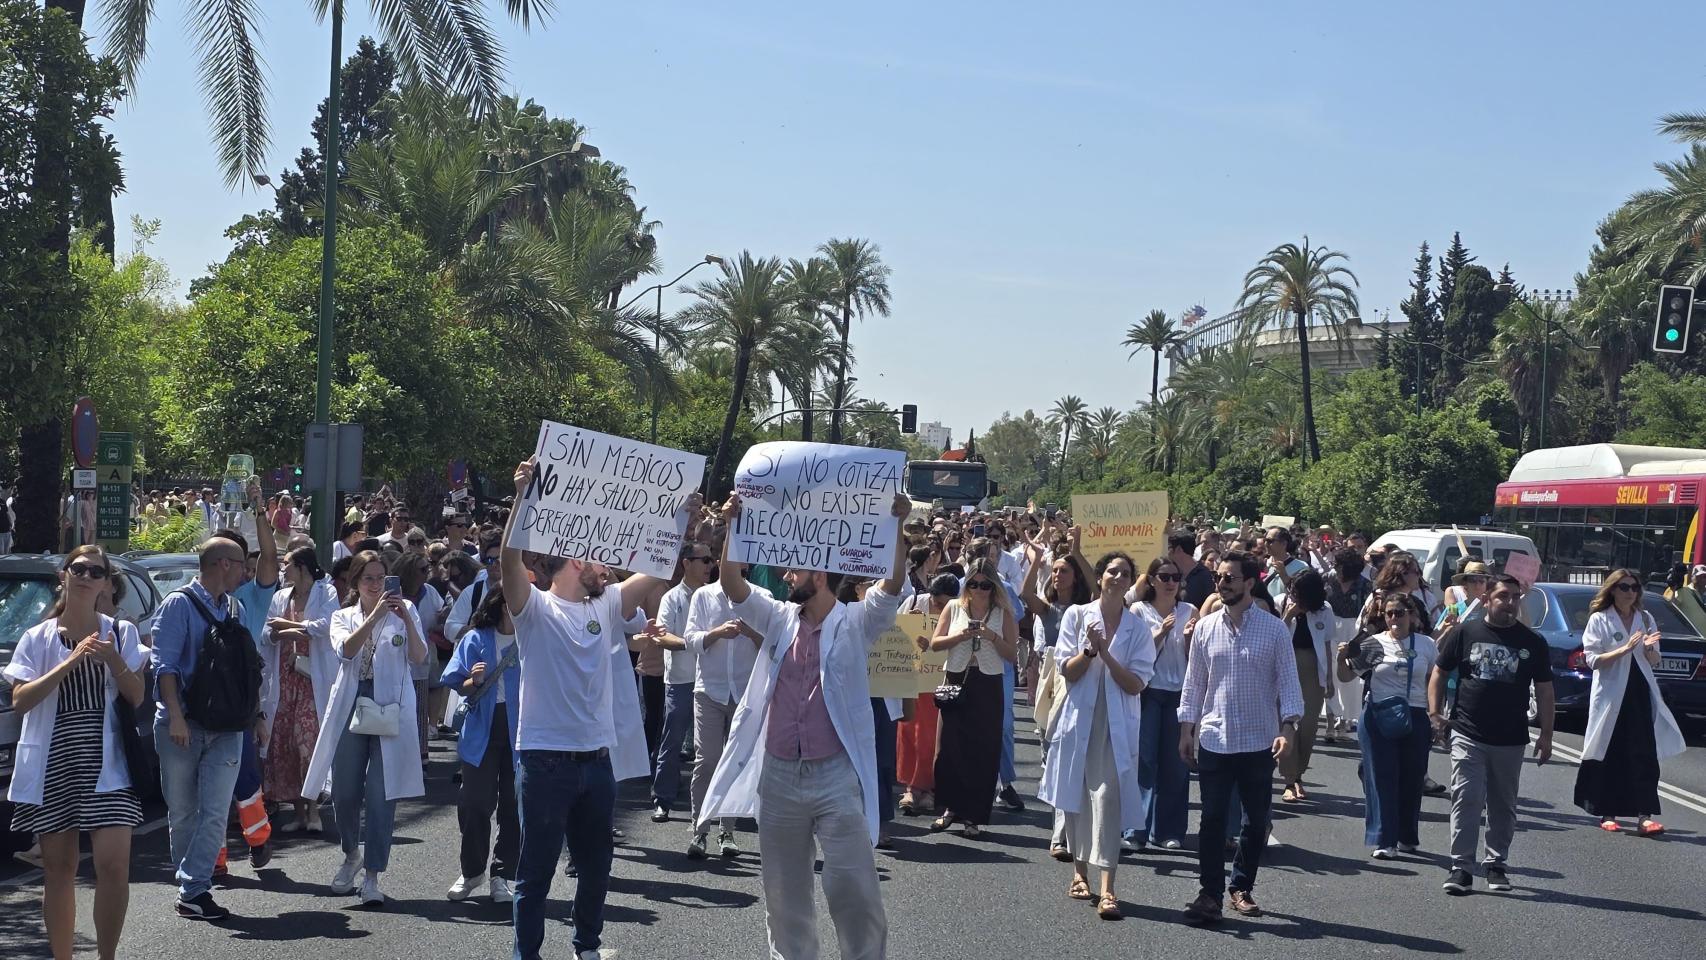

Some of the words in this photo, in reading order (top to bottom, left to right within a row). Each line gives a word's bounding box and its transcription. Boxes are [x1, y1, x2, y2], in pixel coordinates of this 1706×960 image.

[109, 468, 120, 480] A
[600, 445, 686, 492] MÉDICOS
[747, 447, 784, 478] SI
[797, 453, 829, 484] NO
[837, 461, 900, 494] COTIZA
[560, 475, 597, 506] HAY
[649, 492, 684, 519] SIN
[781, 485, 811, 511] NO
[821, 491, 881, 516] EXISTE
[1615, 485, 1649, 504] SEVILLA
[1082, 502, 1122, 519] SALVAR
[1126, 500, 1159, 517] VIDAS
[521, 505, 592, 540] DERECHOS
[590, 516, 613, 543] NO
[613, 519, 645, 550] HAY
[859, 522, 886, 549] EL
[1112, 522, 1154, 537] DORMIR
[741, 540, 832, 570] TRABAJO!
[839, 547, 873, 559] GUARDIAS
[838, 562, 887, 575] VOLUNTARIADO
[1668, 659, 1688, 670] CXM
